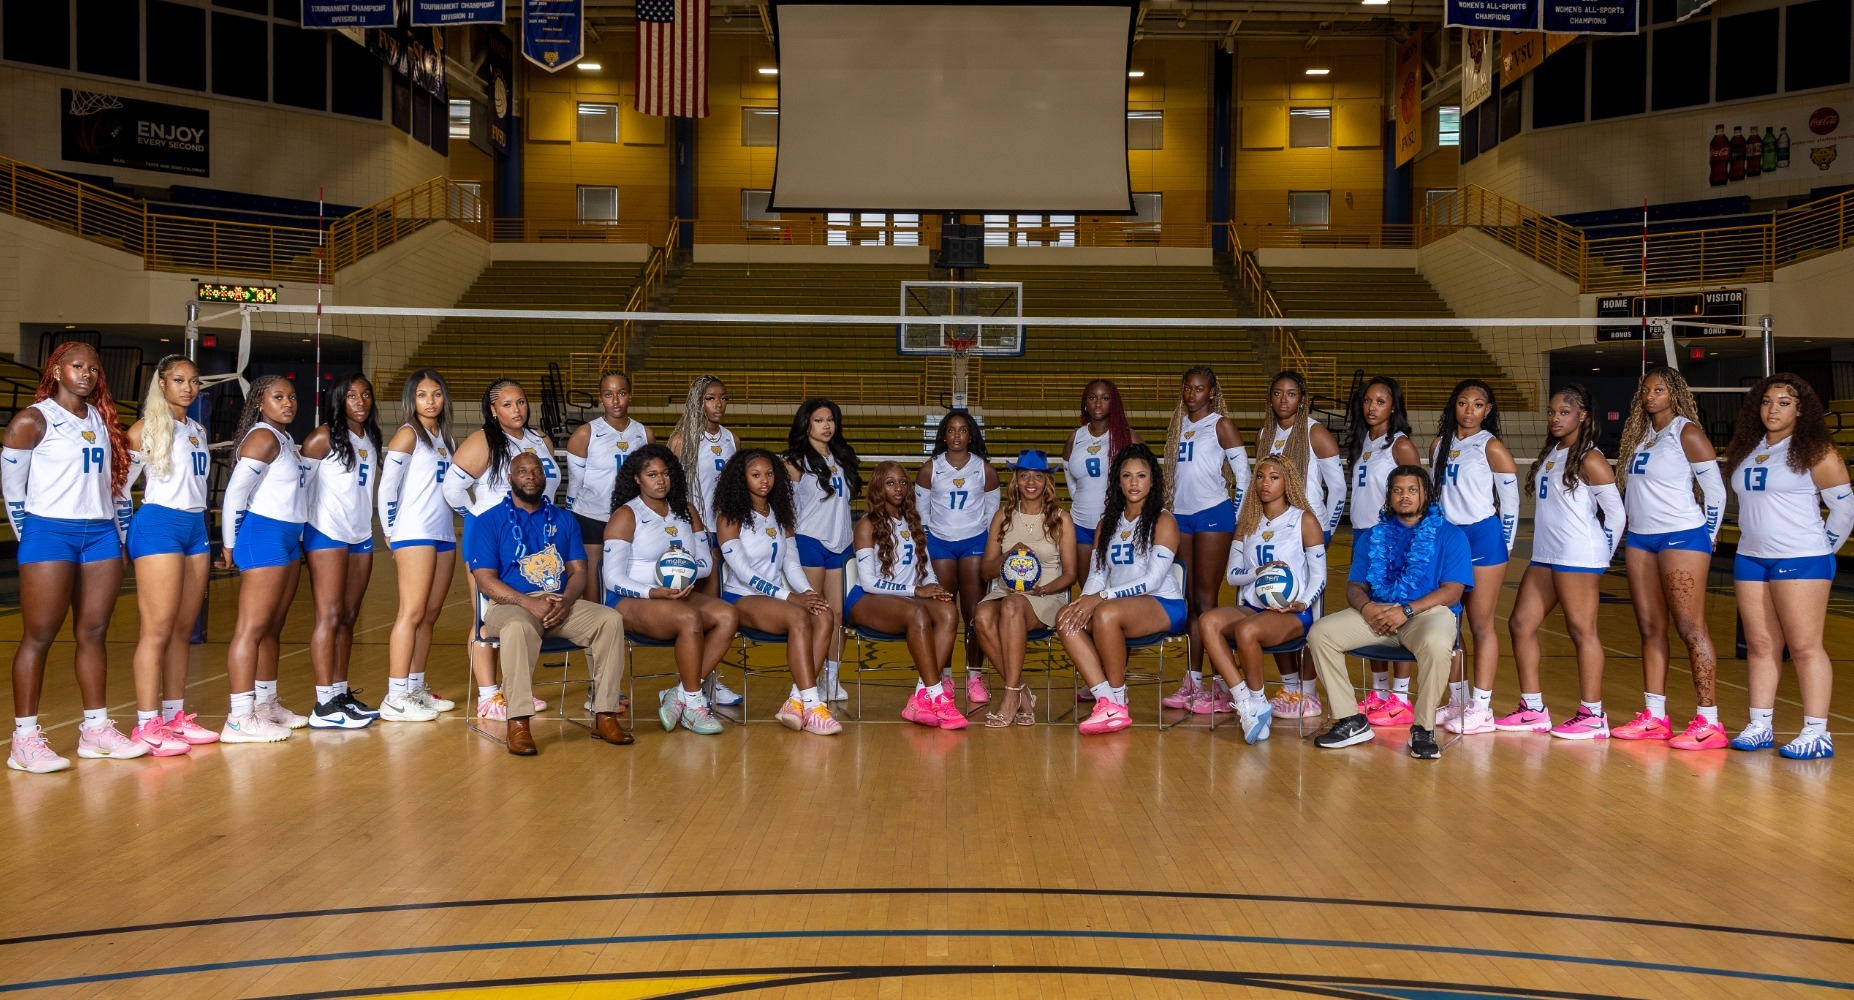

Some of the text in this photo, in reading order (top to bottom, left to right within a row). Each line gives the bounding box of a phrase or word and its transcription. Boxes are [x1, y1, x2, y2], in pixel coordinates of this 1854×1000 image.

[311, 4, 386, 12] TOURNAMENT CHAMPIONS
[420, 0, 496, 10] TOURNAMENT CHAMPIONS
[1458, 2, 1527, 10] WOMEN'S ALL-SPORTS
[1584, 6, 1625, 14] ALL-SPORTS
[331, 15, 357, 23] DIVISION
[440, 13, 466, 21] DIVISION
[1475, 12, 1511, 20] CHAMPIONS
[1509, 39, 1535, 71] FVSU
[138, 120, 204, 144] ENJOY
[138, 136, 204, 152] EVERY SECOND
[1602, 299, 1628, 309] HOME
[1706, 292, 1742, 303] VISITOR
[82, 447, 104, 474] 19
[1178, 441, 1194, 462] 21
[191, 451, 207, 476] 10
[1085, 458, 1100, 478] 8
[358, 464, 369, 487] 5
[1359, 466, 1367, 487] 2
[1744, 467, 1768, 491] 13
[1539, 476, 1549, 499] 6
[950, 490, 968, 510] 17
[1330, 500, 1344, 528] VALLEY
[1707, 505, 1718, 533] VALLEY
[771, 542, 778, 563] 1
[902, 544, 913, 565] 3
[1111, 544, 1135, 565] 23
[1256, 544, 1274, 566] 16
[749, 575, 780, 598] FORT
[874, 579, 906, 590] VALLEY
[1114, 582, 1147, 598] VALLEY
